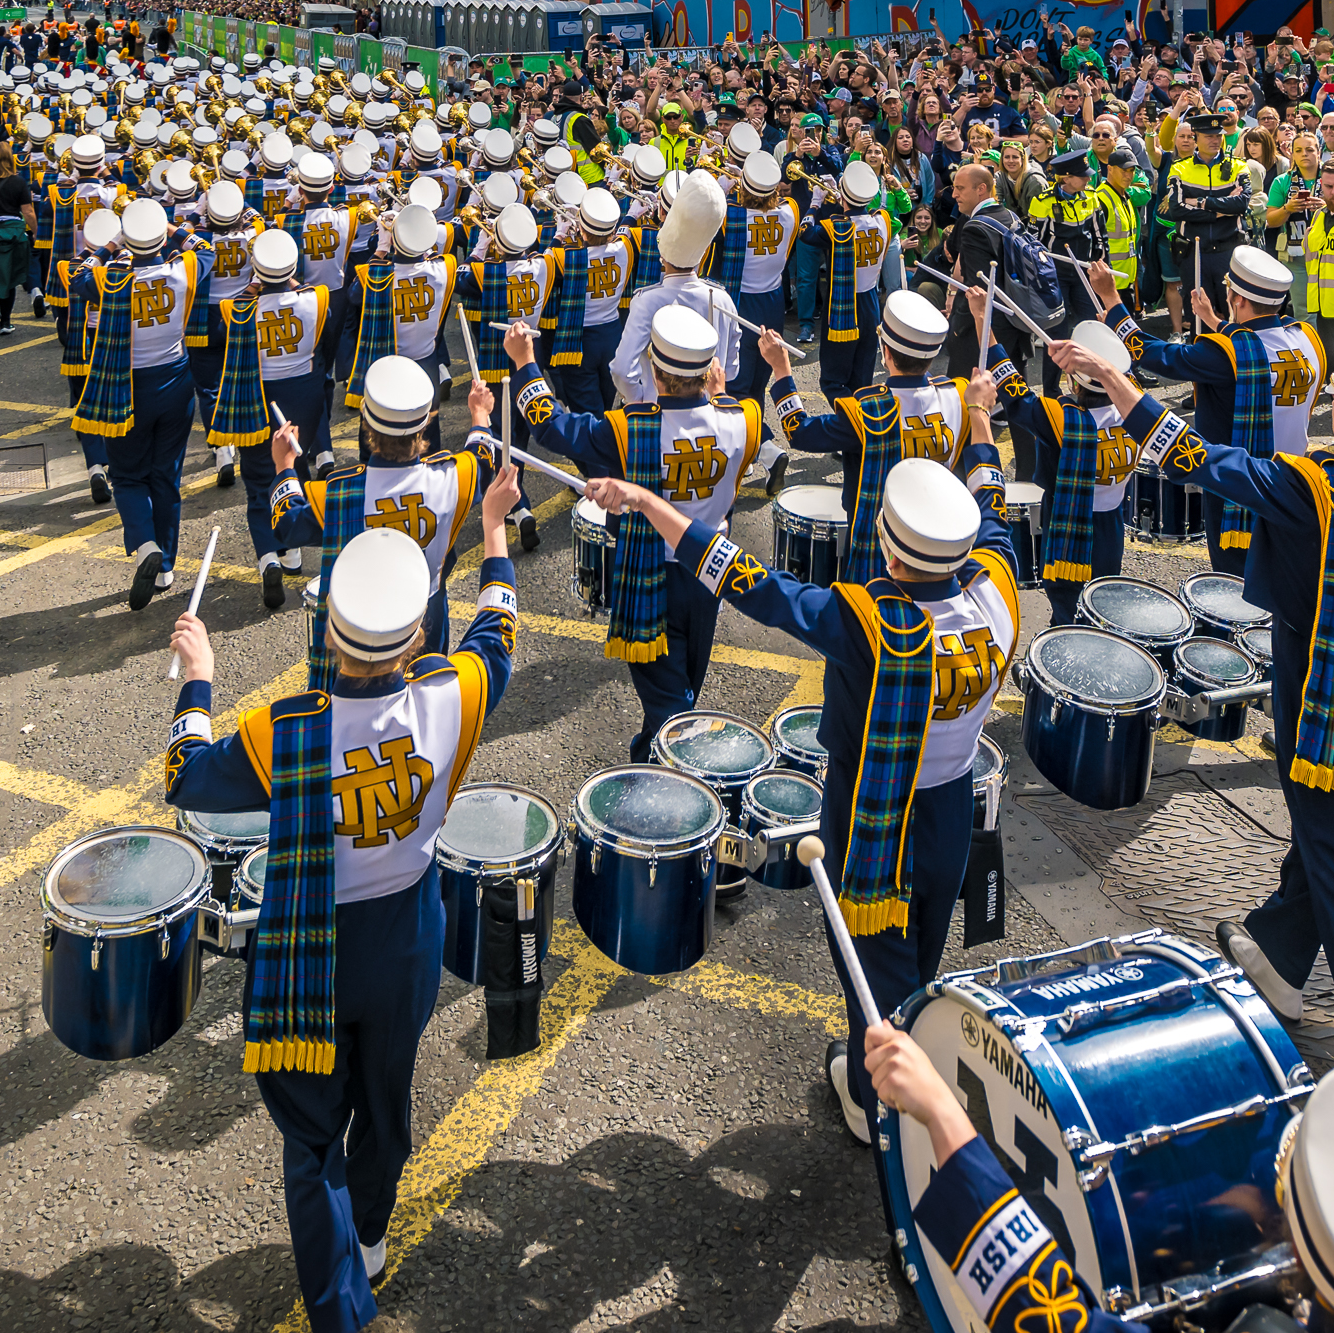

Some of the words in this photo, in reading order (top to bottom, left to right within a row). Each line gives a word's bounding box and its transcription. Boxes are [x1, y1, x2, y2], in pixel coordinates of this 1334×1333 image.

[520, 383, 545, 409] IRISH
[704, 540, 731, 579] RISH
[987, 882, 996, 921] YAMAHA
[981, 1039, 1049, 1120] YAMAHA
